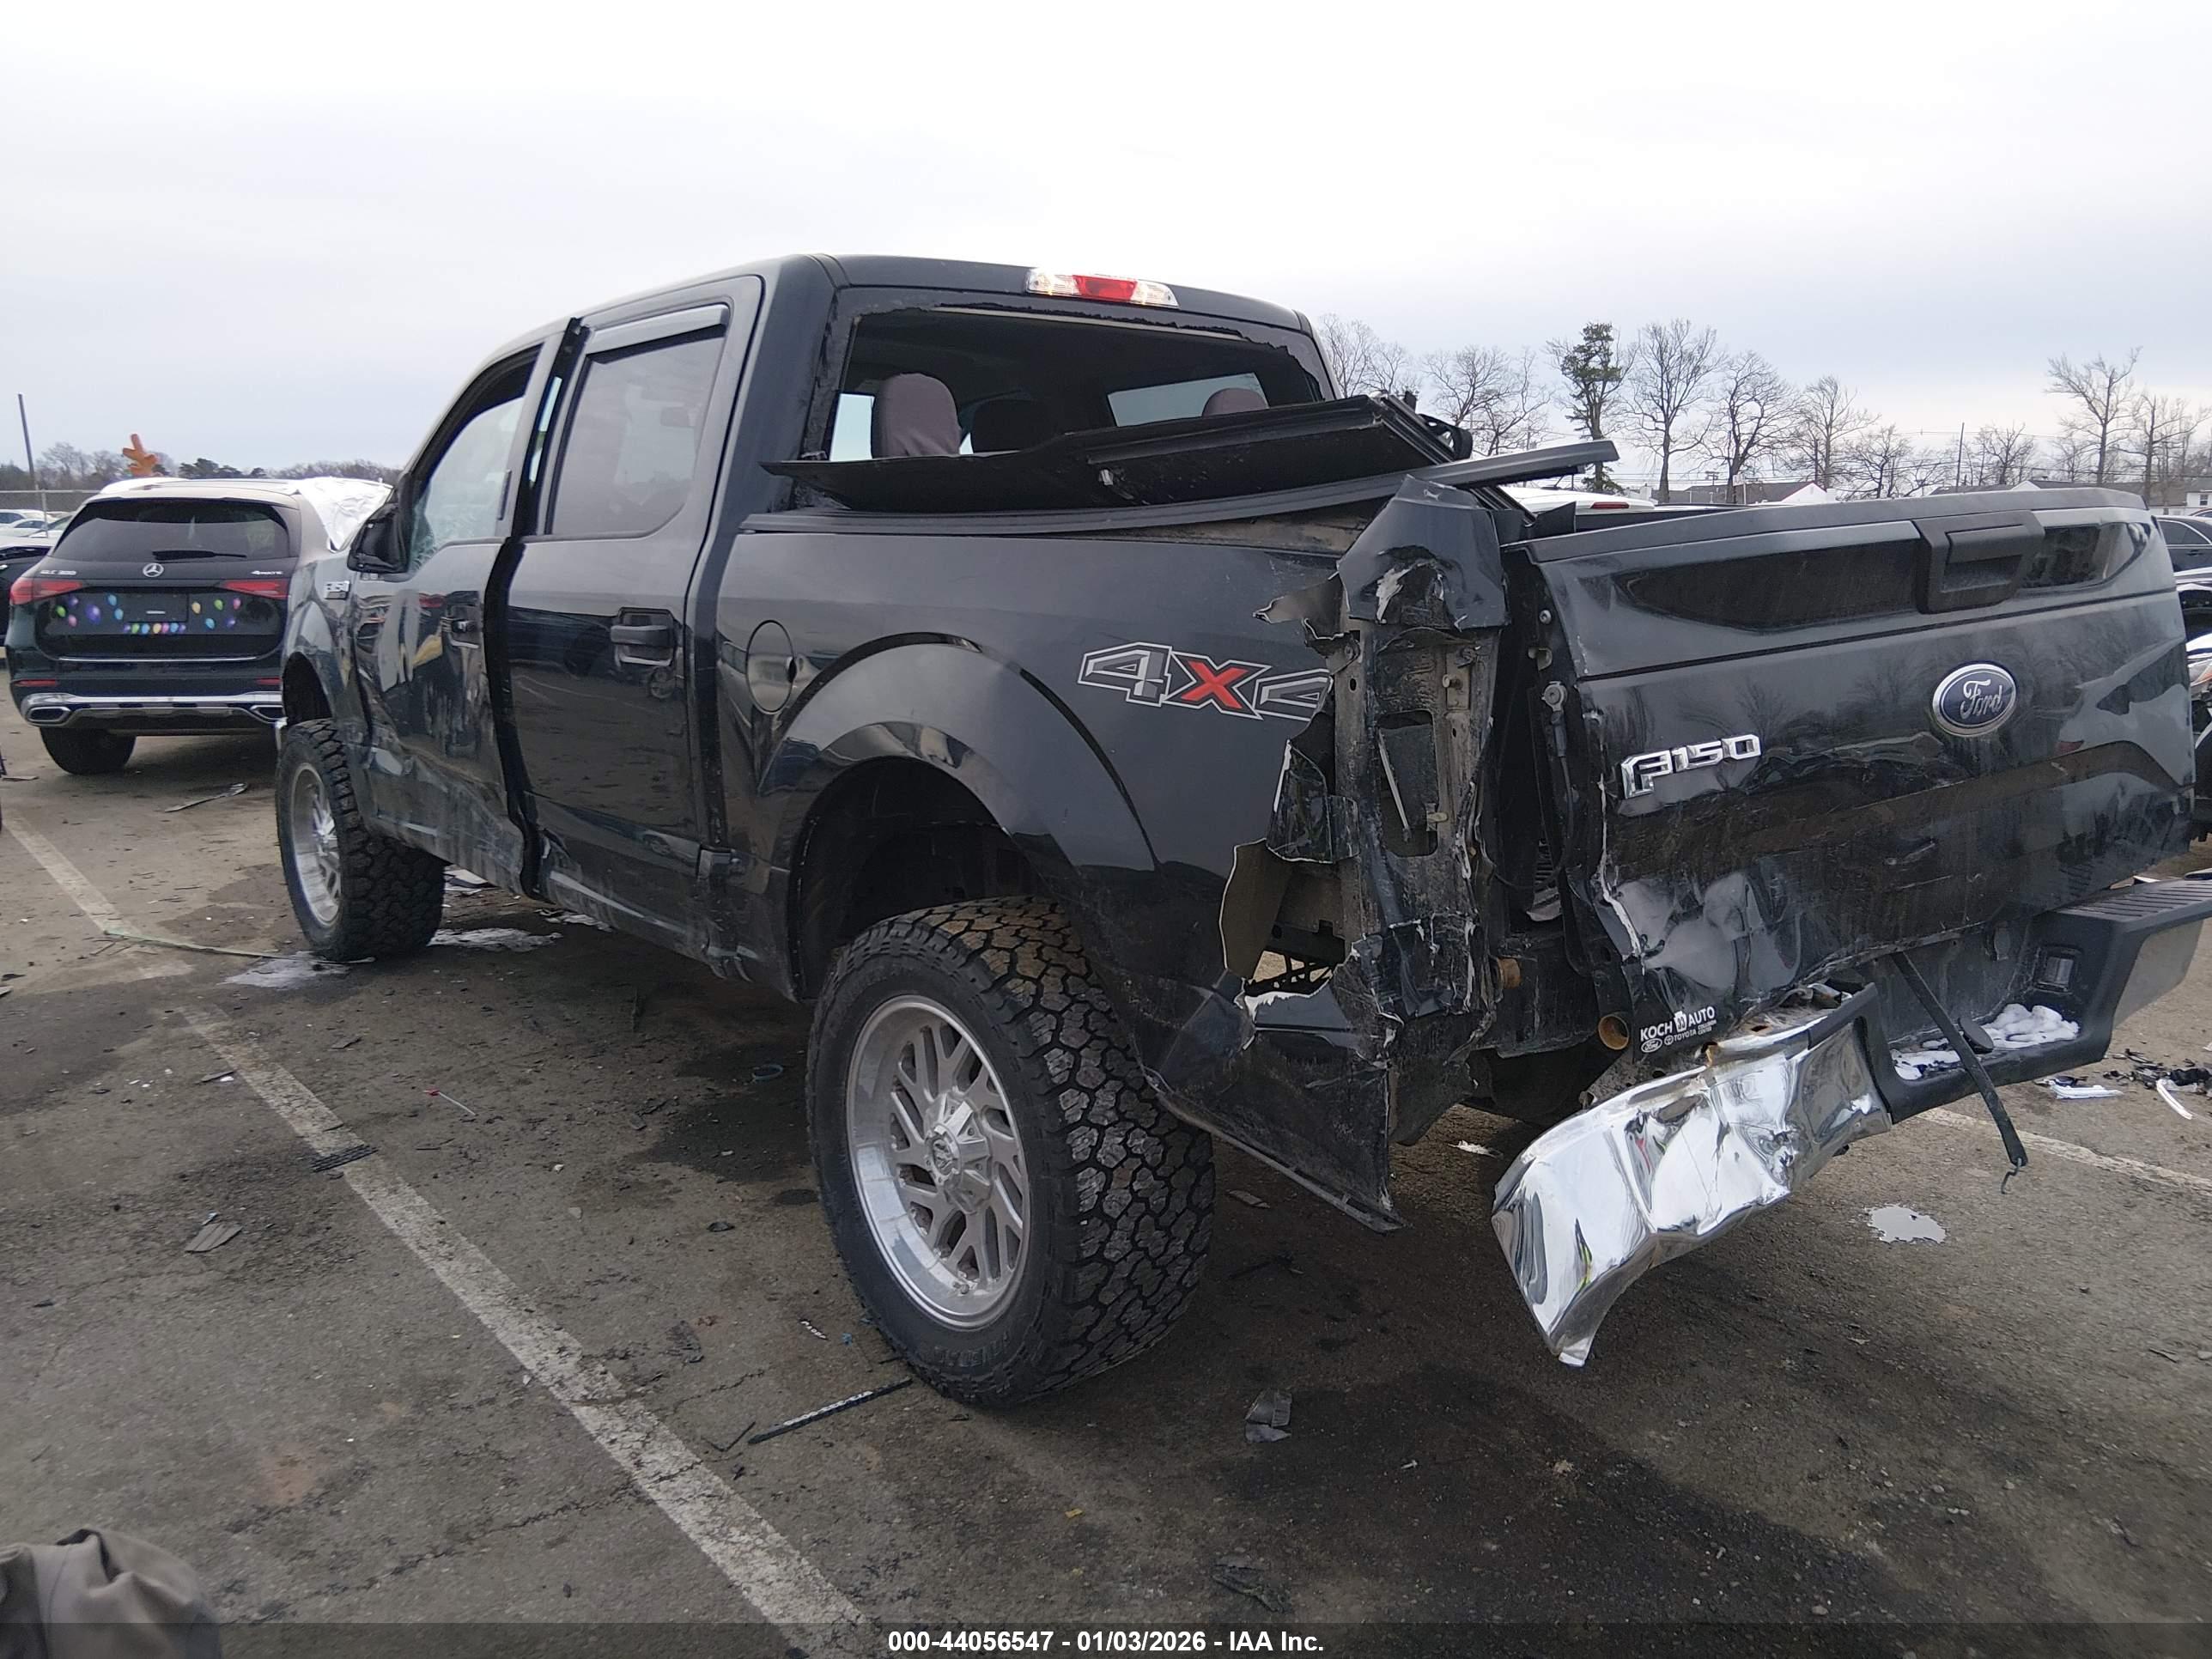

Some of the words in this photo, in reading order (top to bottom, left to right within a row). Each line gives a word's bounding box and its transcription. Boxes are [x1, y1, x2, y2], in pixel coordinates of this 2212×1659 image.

[1960, 679, 2003, 720] Ford
[1621, 734, 1761, 799] F150
[1640, 1021, 1673, 1042] KOCH
[1688, 1006, 1716, 1027] AUTO
[1674, 1029, 1697, 1042] TOYOTA
